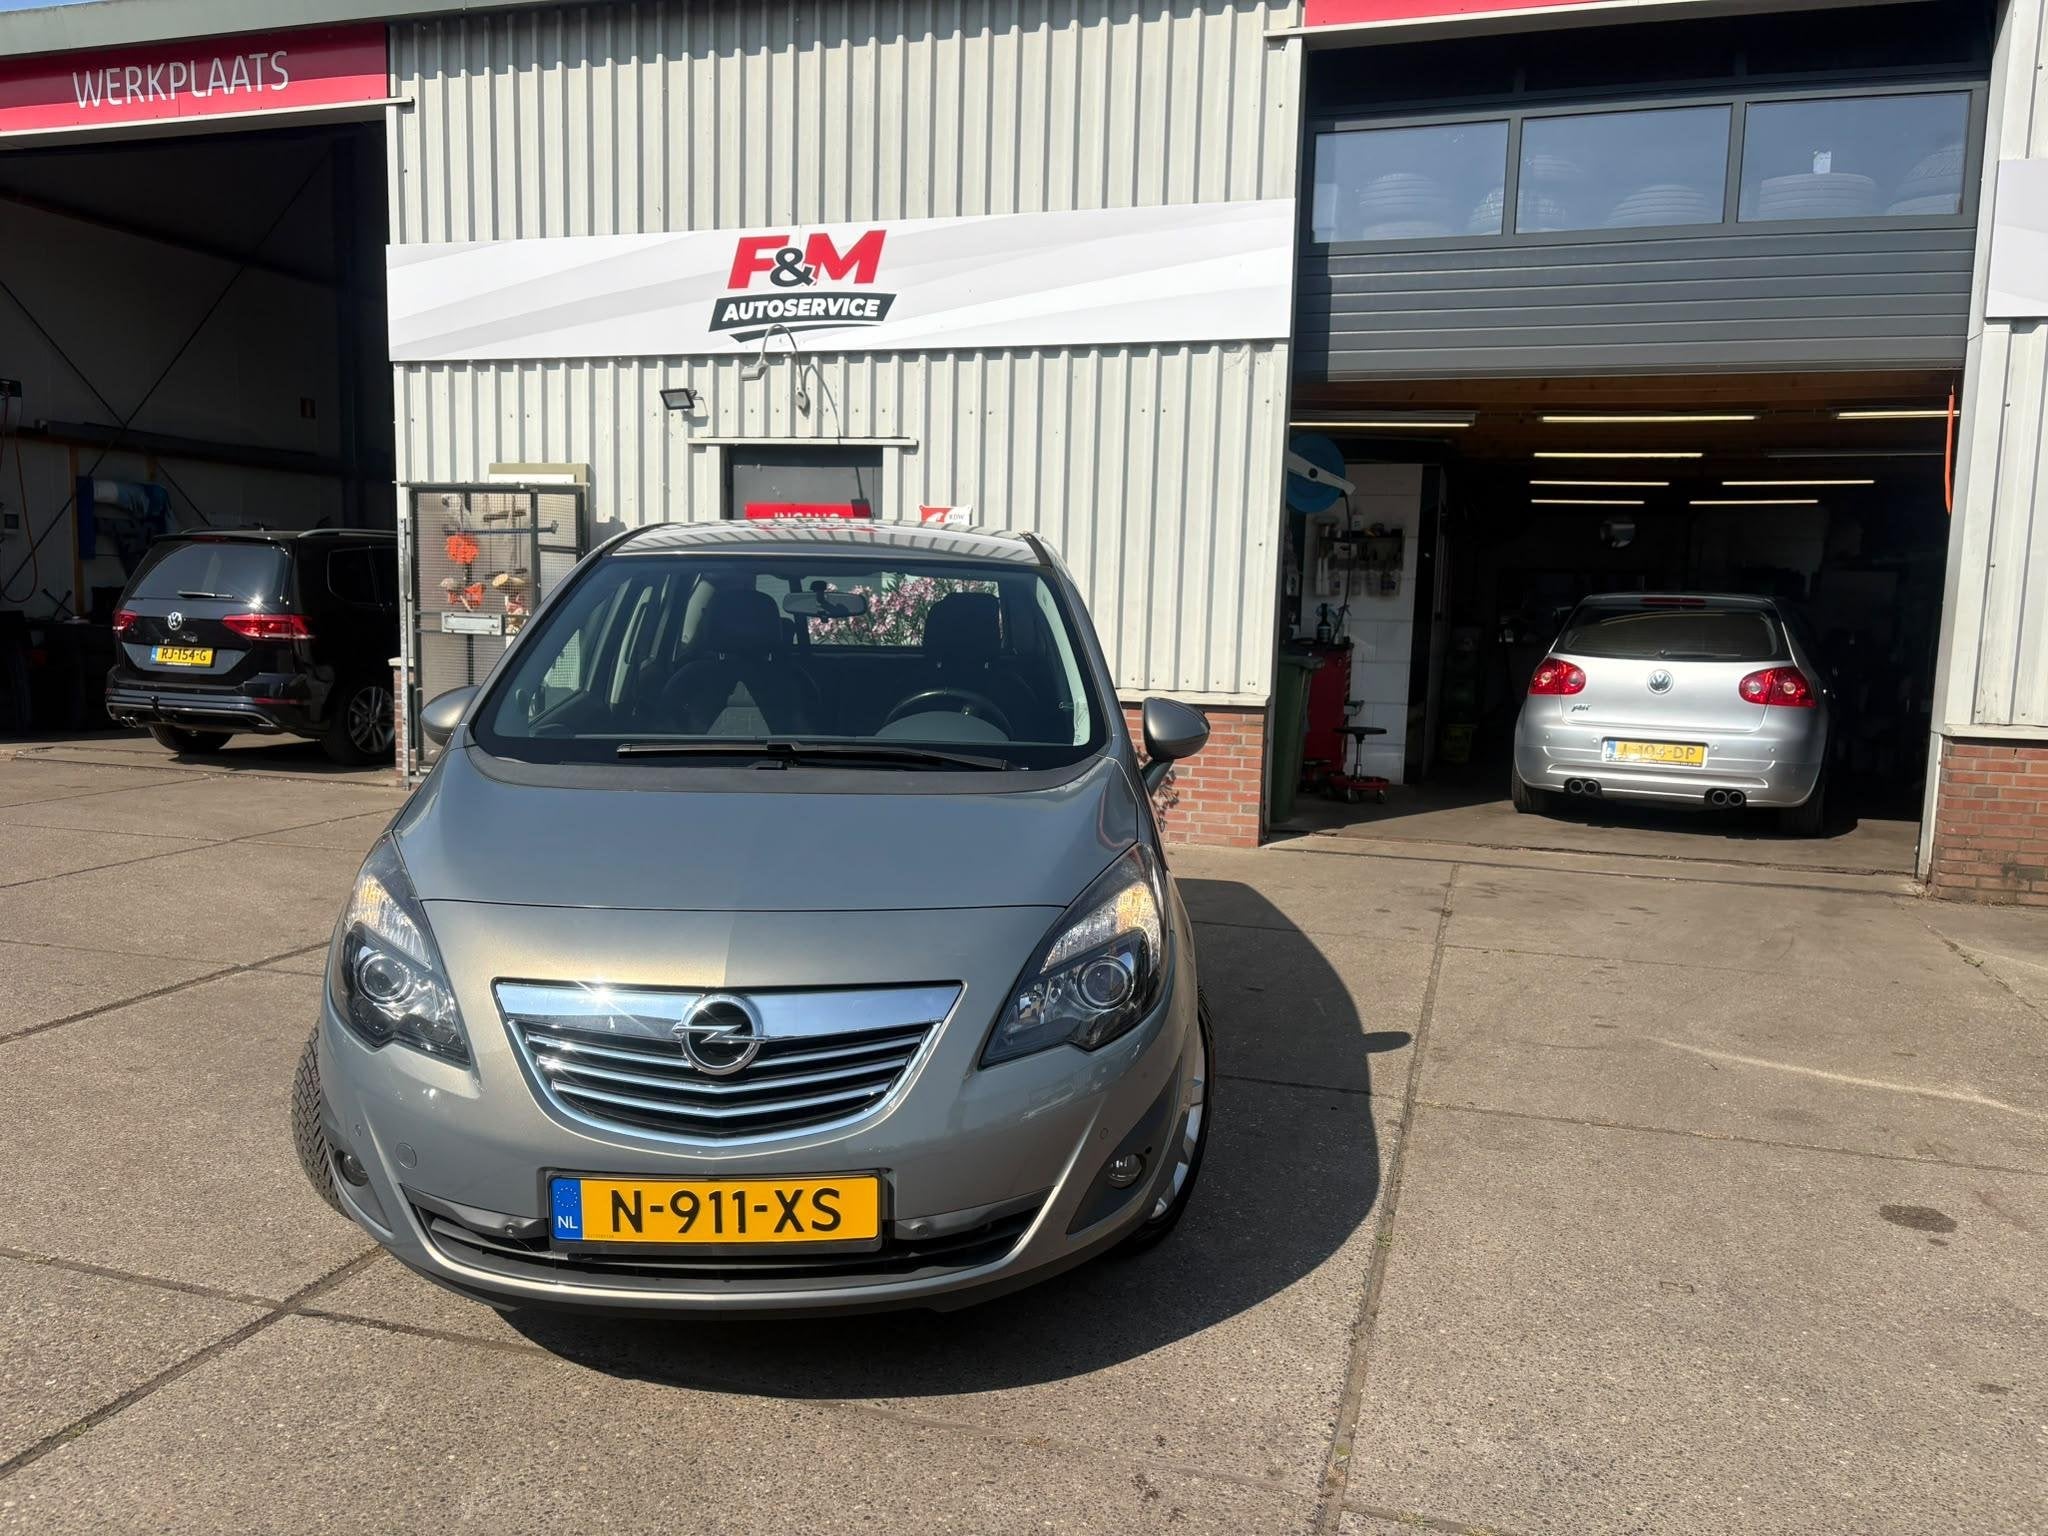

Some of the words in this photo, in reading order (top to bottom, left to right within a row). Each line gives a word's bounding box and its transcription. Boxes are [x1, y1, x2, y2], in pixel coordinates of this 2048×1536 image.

[72, 51, 289, 109] WERKPLAATS
[727, 229, 887, 290] F&M
[721, 298, 881, 322] AUTOSERVICE
[161, 648, 207, 661] RJ-154-G
[558, 1215, 579, 1230] NL
[611, 1187, 842, 1234] N-911-XS
